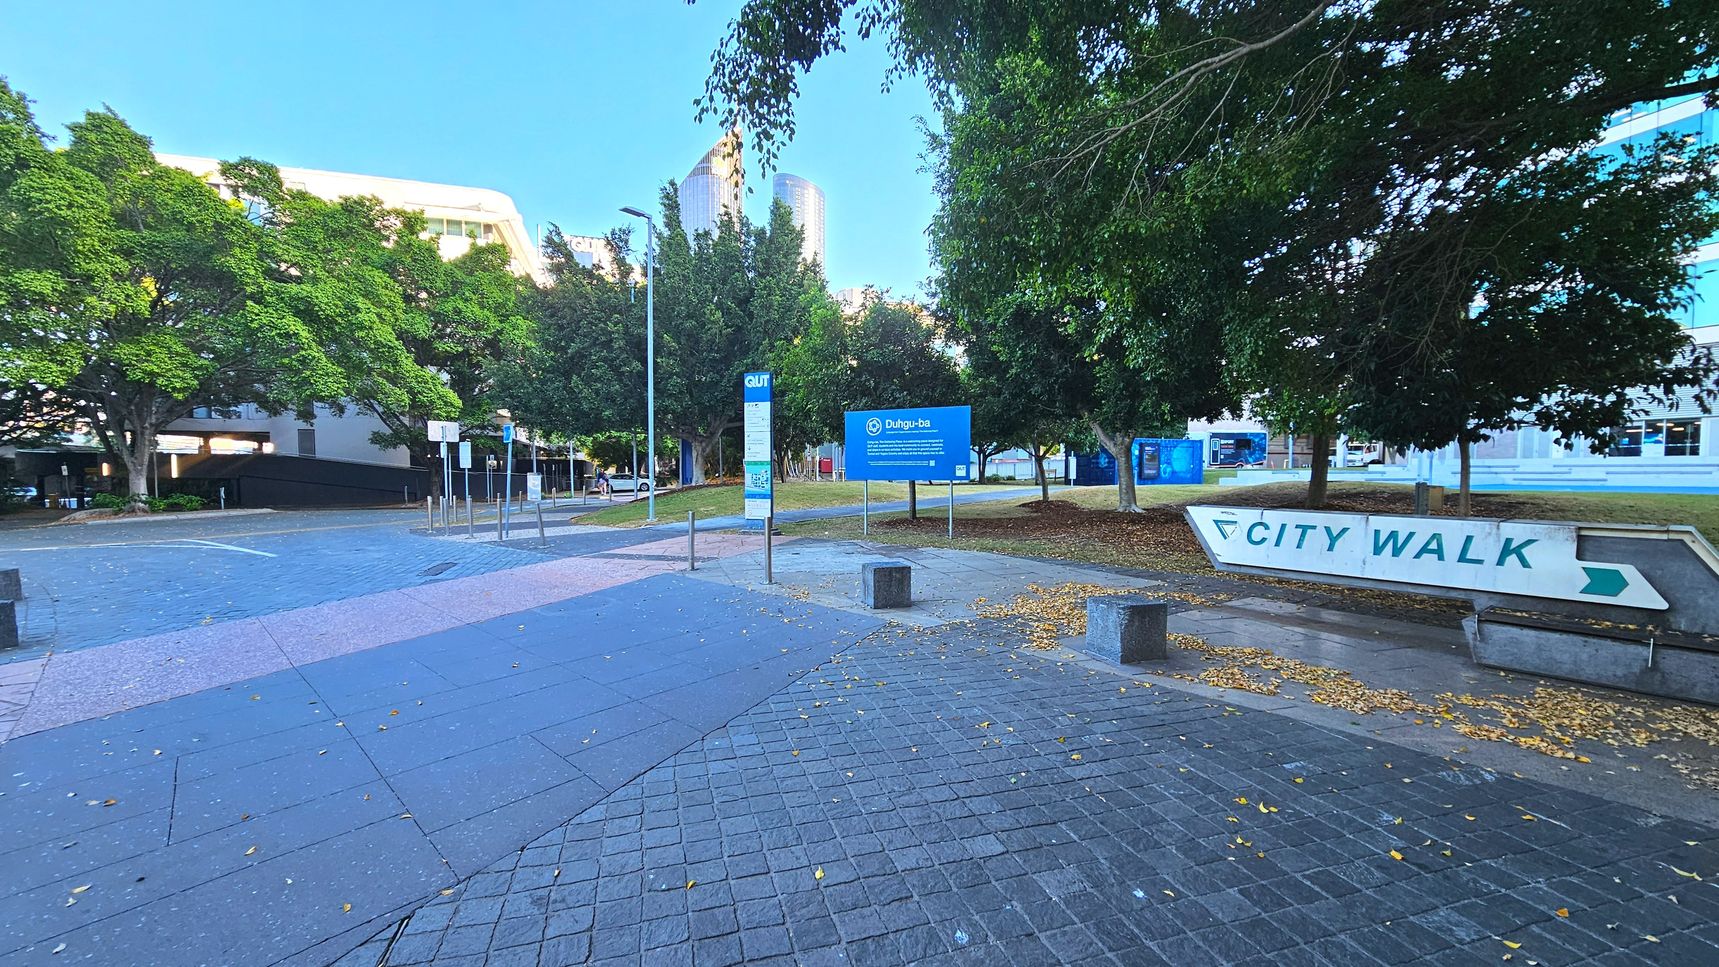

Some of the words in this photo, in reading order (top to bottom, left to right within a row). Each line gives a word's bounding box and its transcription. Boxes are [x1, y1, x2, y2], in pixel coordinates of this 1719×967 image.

[745, 374, 770, 388] QUT
[885, 418, 931, 430] Duhgu-ba
[1246, 521, 1350, 552] CITY
[1372, 529, 1540, 569] WALK
